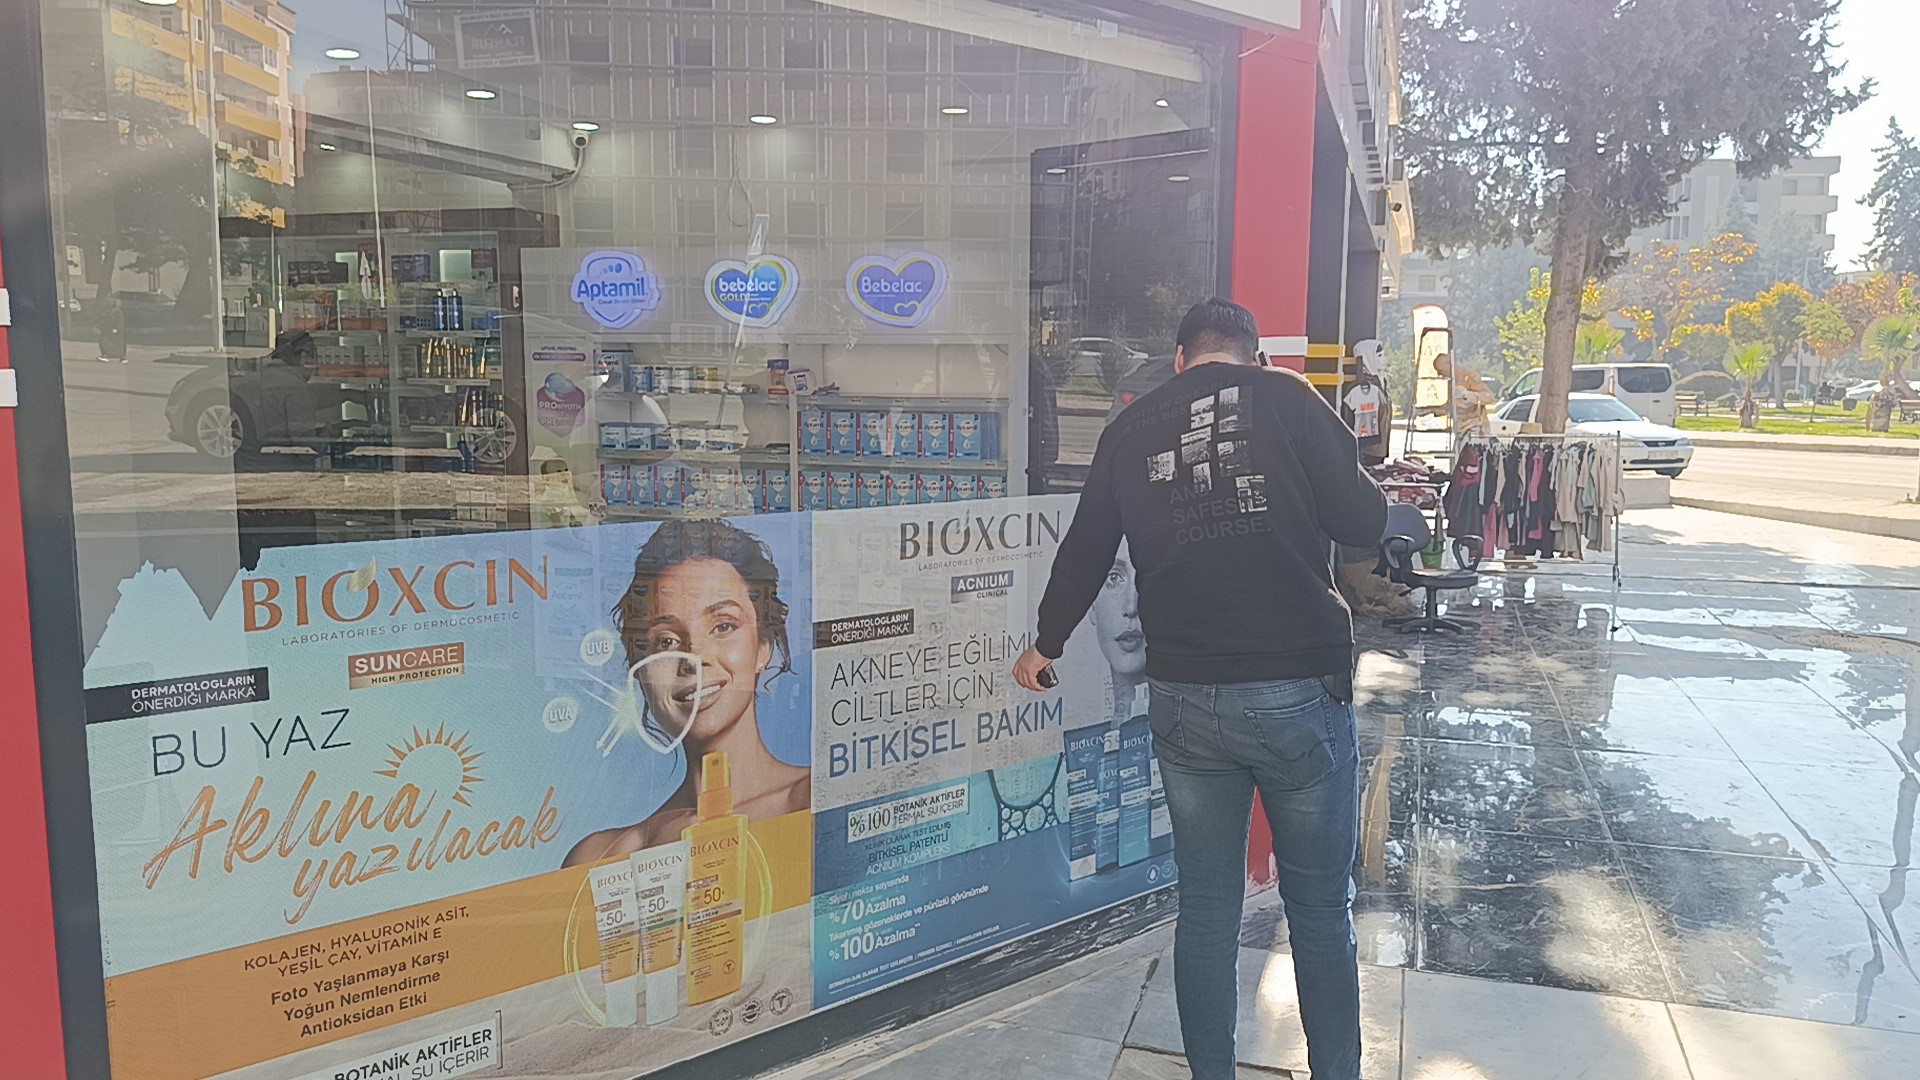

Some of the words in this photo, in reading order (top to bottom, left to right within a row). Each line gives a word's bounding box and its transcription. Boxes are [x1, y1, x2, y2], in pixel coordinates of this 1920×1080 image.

[577, 277, 648, 300] Aptamil
[719, 277, 776, 292] bebelac
[861, 277, 922, 293] Bebelac
[1172, 497, 1238, 525] SAFES
[900, 509, 1061, 560] BIOXCIN
[1176, 516, 1272, 545] COURSE.
[918, 560, 974, 571] LABORATORIES
[975, 557, 985, 565] OF
[986, 551, 1044, 564] DERMOCOSMETIC
[242, 555, 547, 632] BIOXCIN
[957, 573, 1009, 592] ACNIUM
[976, 589, 1009, 599] CLINICAL
[281, 626, 386, 646] LABORATORIES
[391, 623, 409, 634] OF
[413, 611, 520, 632] DERMOCOSMETIC
[831, 613, 909, 632] DERMATOLOGLARIN
[355, 646, 459, 674] SUNCARE
[586, 641, 610, 656] UVB
[371, 675, 396, 685] HIGH
[399, 667, 460, 682] PROTECTION
[830, 646, 938, 690] AKNEYE
[131, 674, 255, 700] DERMATOLOGLARIN
[831, 683, 937, 728] CİLTLER
[947, 669, 994, 708] İÇİN
[131, 691, 202, 713] ÖNERDİĞİ
[549, 707, 572, 723] UVA
[152, 726, 227, 776] BU
[250, 708, 352, 759] YAZ
[829, 718, 966, 778] BİTKİSEL
[977, 696, 1063, 745] BAKIM
[850, 809, 891, 838] %100
[893, 797, 928, 815] BOTANİK
[929, 787, 965, 804] AKTİFLER
[927, 805, 939, 816] SU
[142, 770, 437, 889] Aklına
[913, 827, 928, 838] TEST
[284, 786, 566, 925] yazılacak
[637, 854, 683, 873] BIOXCIN
[866, 857, 902, 876] ACNIUM
[904, 843, 951, 865] KOMPLEKS
[868, 844, 908, 863] BİTKİSEL
[829, 898, 865, 925] %70
[865, 894, 906, 916] Azalma
[913, 906, 923, 915] ve
[244, 942, 326, 971] KOLAJEN,
[330, 915, 430, 950] HYALURONİK
[434, 906, 469, 924] ASİT,
[277, 958, 324, 977] YEŞİL
[327, 948, 362, 967] ÇAY,
[366, 930, 429, 956] VİTAMİN
[433, 927, 443, 939] E
[828, 931, 875, 961] %100
[271, 987, 308, 1005] Foto
[314, 963, 407, 995] Yaşlanmaya
[411, 950, 450, 969] Karşı
[283, 1001, 335, 1021] Yoğun
[340, 971, 441, 1008] Nemlendirme
[300, 1004, 394, 1037] Antioksidan
[399, 991, 428, 1011] Etki
[415, 1028, 492, 1064] AKTİFLER
[411, 1062, 434, 1080] SU
[439, 1046, 490, 1074] İÇERİR
